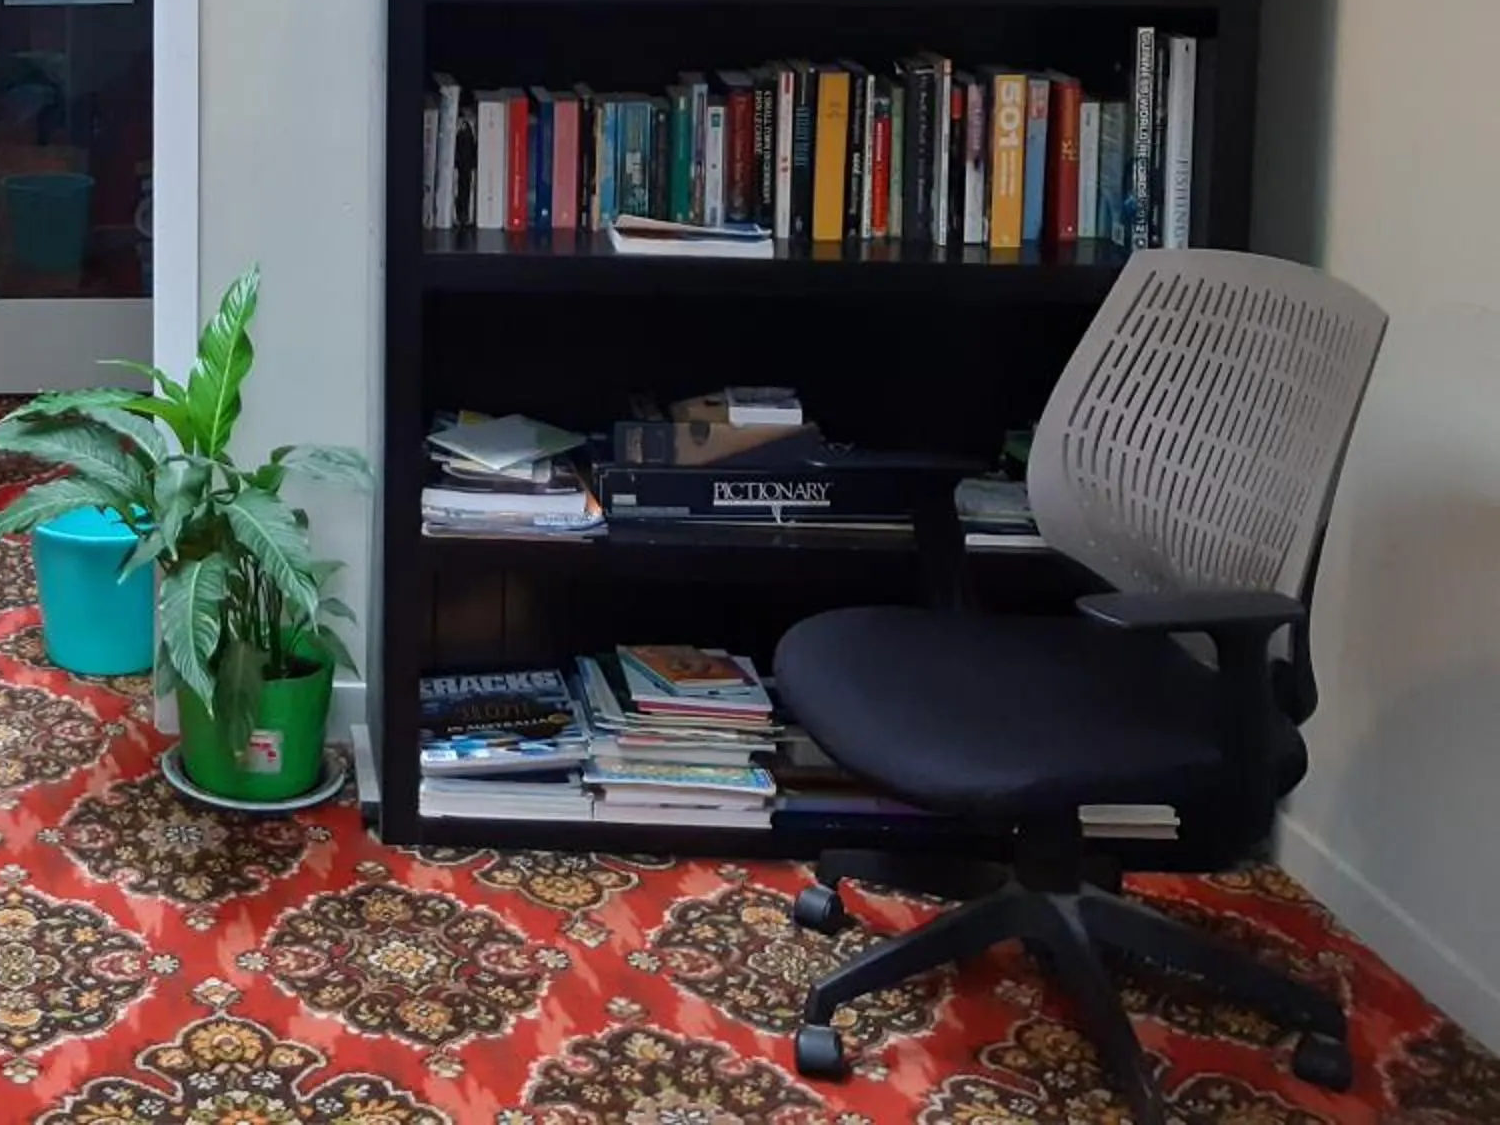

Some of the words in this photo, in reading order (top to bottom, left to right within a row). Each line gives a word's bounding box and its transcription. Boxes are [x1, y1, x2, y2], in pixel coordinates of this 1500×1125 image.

[999, 80, 1021, 148] 501
[1138, 97, 1150, 141] WORLD
[713, 482, 830, 501] PICTIONARY
